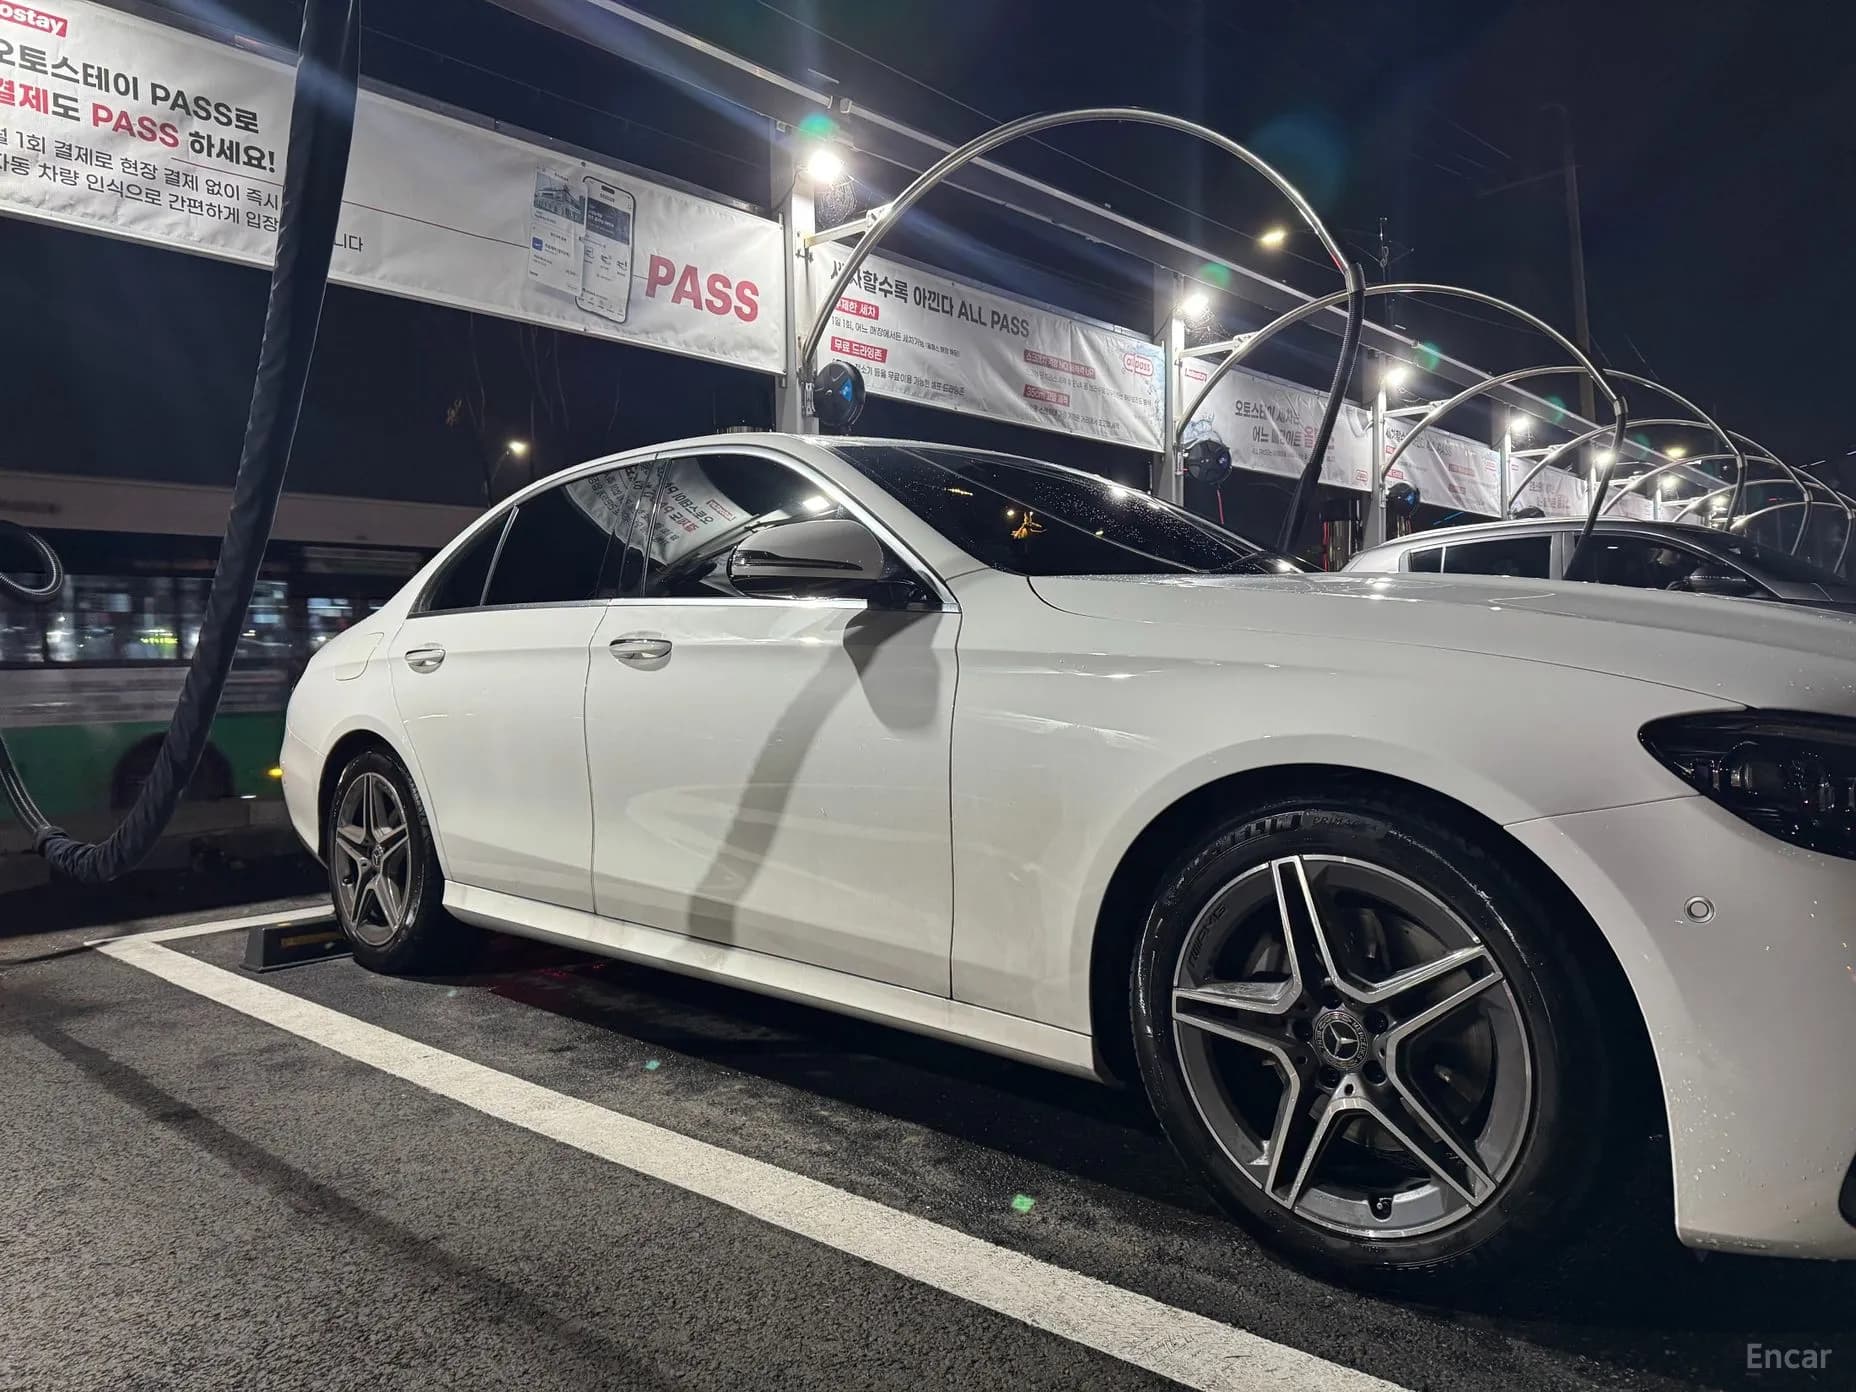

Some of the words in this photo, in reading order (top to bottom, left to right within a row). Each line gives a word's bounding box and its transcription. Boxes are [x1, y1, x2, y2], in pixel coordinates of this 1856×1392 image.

[91, 103, 180, 149] PASS
[188, 131, 276, 173] 하세요!
[151, 82, 260, 134] PASS로
[16, 130, 46, 155] 1회
[54, 140, 114, 170] 결제로
[120, 157, 159, 181] 현장
[163, 168, 199, 192] 결제
[205, 178, 240, 201] 없이
[246, 187, 278, 211] 즉시
[38, 162, 80, 187] 차량
[86, 173, 162, 206] 인식으로
[168, 193, 240, 224] 간편하게
[245, 211, 279, 233] 입장
[645, 254, 760, 323] PASS
[913, 286, 955, 317] 아낀다
[958, 299, 988, 328] ALL
[990, 311, 1031, 339] PASS
